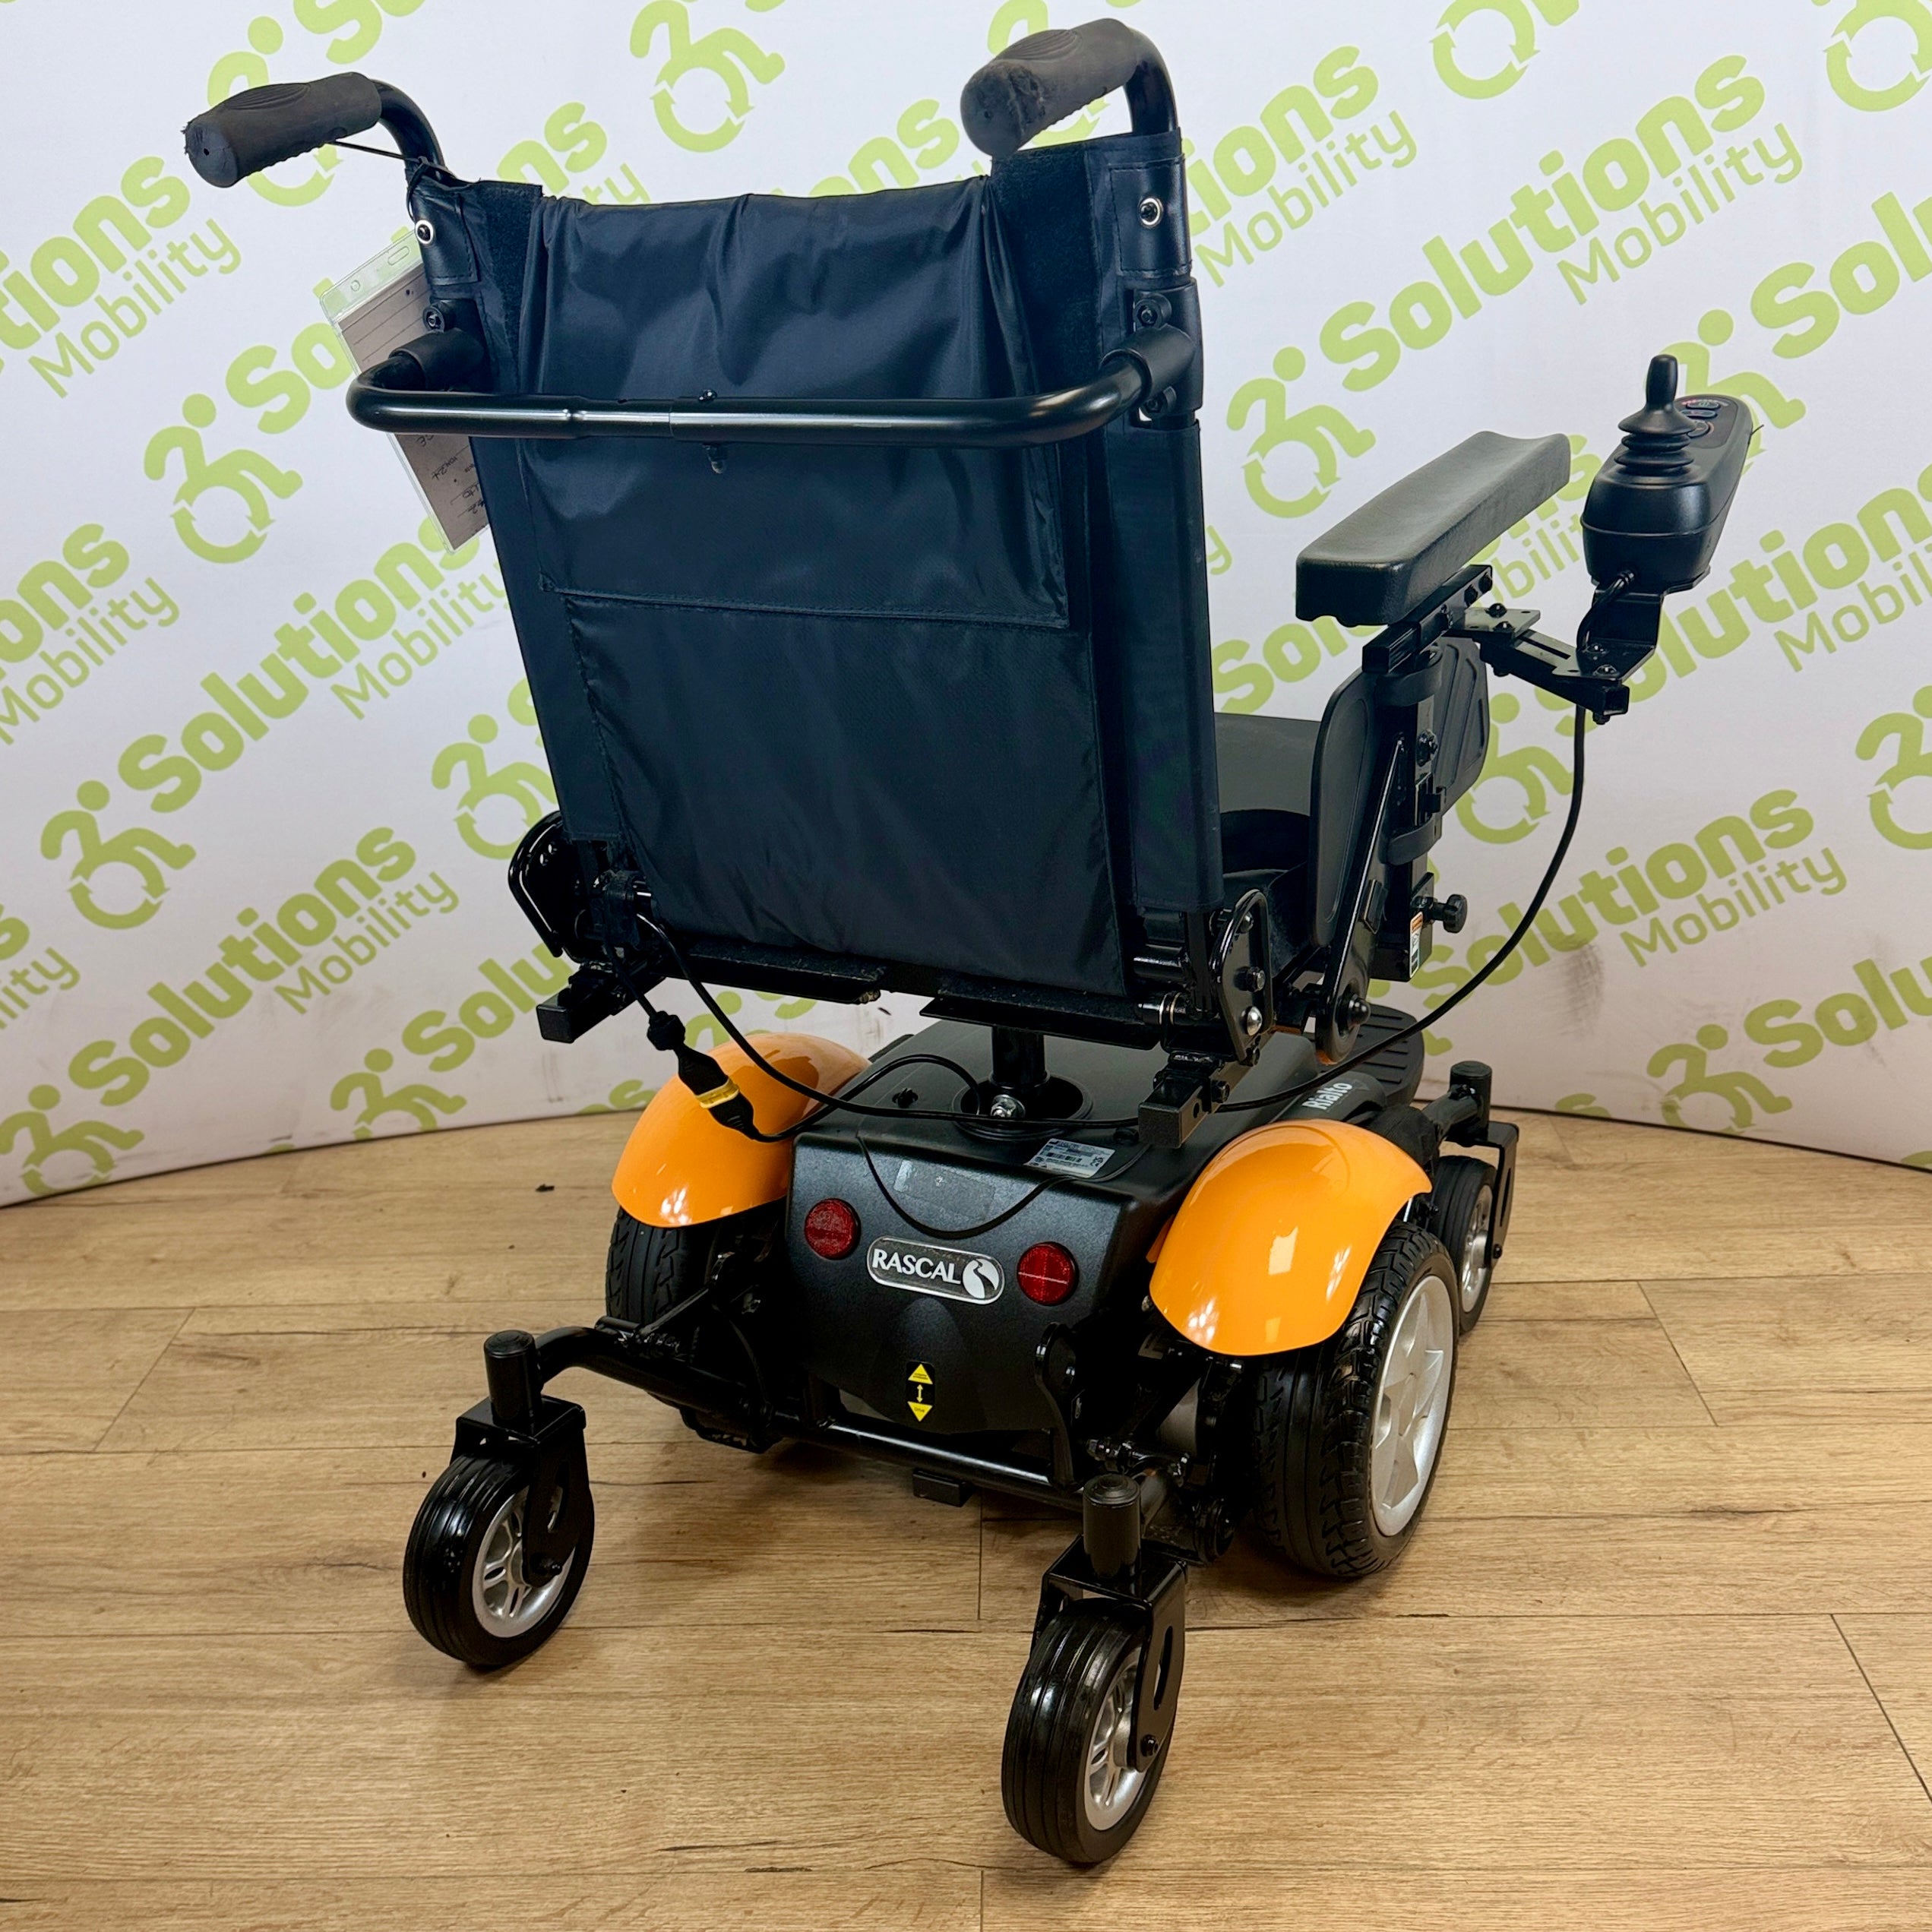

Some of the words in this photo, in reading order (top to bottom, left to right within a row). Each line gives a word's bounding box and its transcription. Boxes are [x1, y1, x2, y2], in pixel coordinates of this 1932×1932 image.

[1194, 109, 1418, 289] Mobility
[1319, 54, 1766, 393] Solutions
[1556, 122, 1804, 306] Mobility
[27, 217, 242, 400] Mobility
[0, 576, 180, 746] Mobility
[117, 517, 480, 814] Solutions
[1773, 542, 1932, 673] Mobil
[68, 827, 417, 1107] Solutions
[273, 871, 460, 1015] Mobility
[1409, 789, 1816, 1011] Solutions
[1619, 847, 1848, 969] Mobility
[1301, 1083, 1353, 1111] Rialto
[871, 1248, 963, 1285] RASCAL
